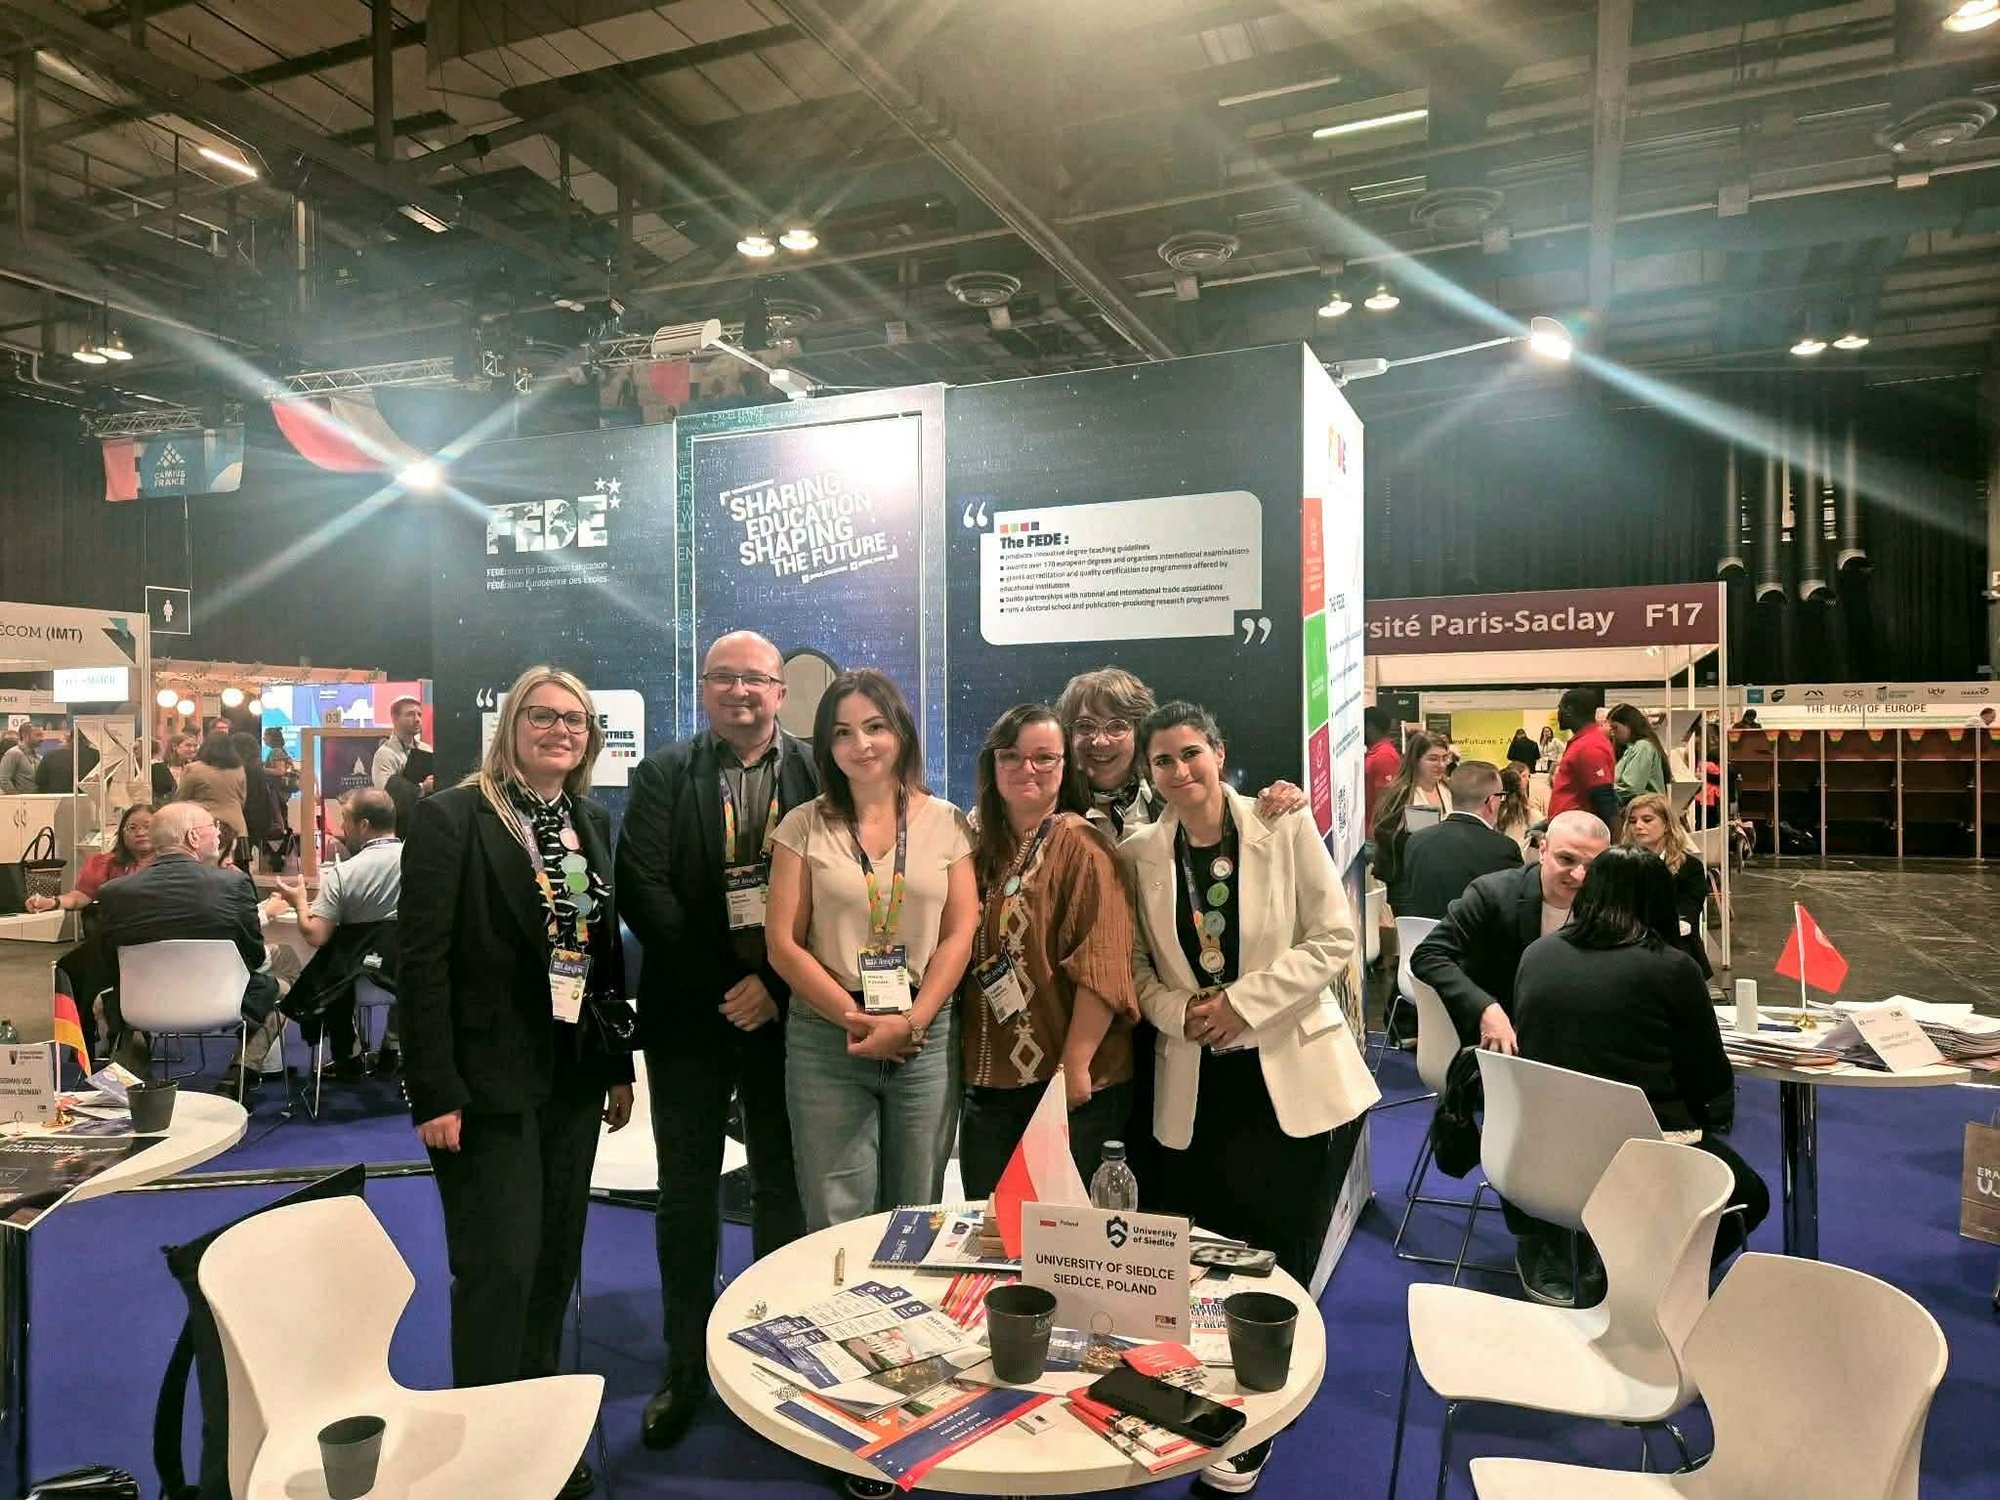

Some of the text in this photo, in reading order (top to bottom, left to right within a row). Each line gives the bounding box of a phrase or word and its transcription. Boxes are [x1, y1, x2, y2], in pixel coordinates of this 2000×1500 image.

[730, 469, 841, 522] SHARING
[486, 494, 608, 555] FEDE
[746, 491, 873, 541] EDUCATION
[739, 516, 854, 566] SHAPING
[1000, 536, 1024, 549] The
[1027, 533, 1061, 547] FEDE
[1066, 548, 1087, 557] degree
[1089, 545, 1116, 554] teaching
[1117, 543, 1150, 553] guidelines
[772, 532, 889, 577] THE FUTURE
[1056, 560, 1086, 568] european
[1087, 557, 1111, 566] degrees
[1160, 551, 1202, 560] international
[1203, 547, 1250, 557] examinations
[1079, 568, 1101, 577] quality
[1102, 565, 1140, 574] certification
[1150, 563, 1192, 573] programmes
[1193, 560, 1218, 569] offered
[1219, 560, 1228, 568] by
[1024, 593, 1063, 603] partnerships
[1064, 591, 1079, 599] with
[1079, 590, 1105, 598] national
[1106, 589, 1119, 597] and
[1181, 583, 1223, 592] associations
[1051, 602, 1071, 610] school
[1071, 602, 1085, 610] and
[1085, 598, 1155, 609] publication-producing
[1156, 596, 1185, 605] research
[1186, 594, 1230, 604] programmes
[1430, 606, 1615, 637] Paris-Saclay
[1645, 602, 1703, 628] F17
[46, 625, 83, 643] (IMT)
[1806, 703, 1927, 713] THE HEART OF EUROPE
[604, 730, 634, 740] NTRIES
[1059, 1219, 1178, 1240] Poland University
[1143, 1237, 1175, 1248] Siedlce
[1036, 1253, 1175, 1281] UNIVERSITY OF SIEDLCE
[1054, 1273, 1157, 1296] SIEDLCE, POLAND
